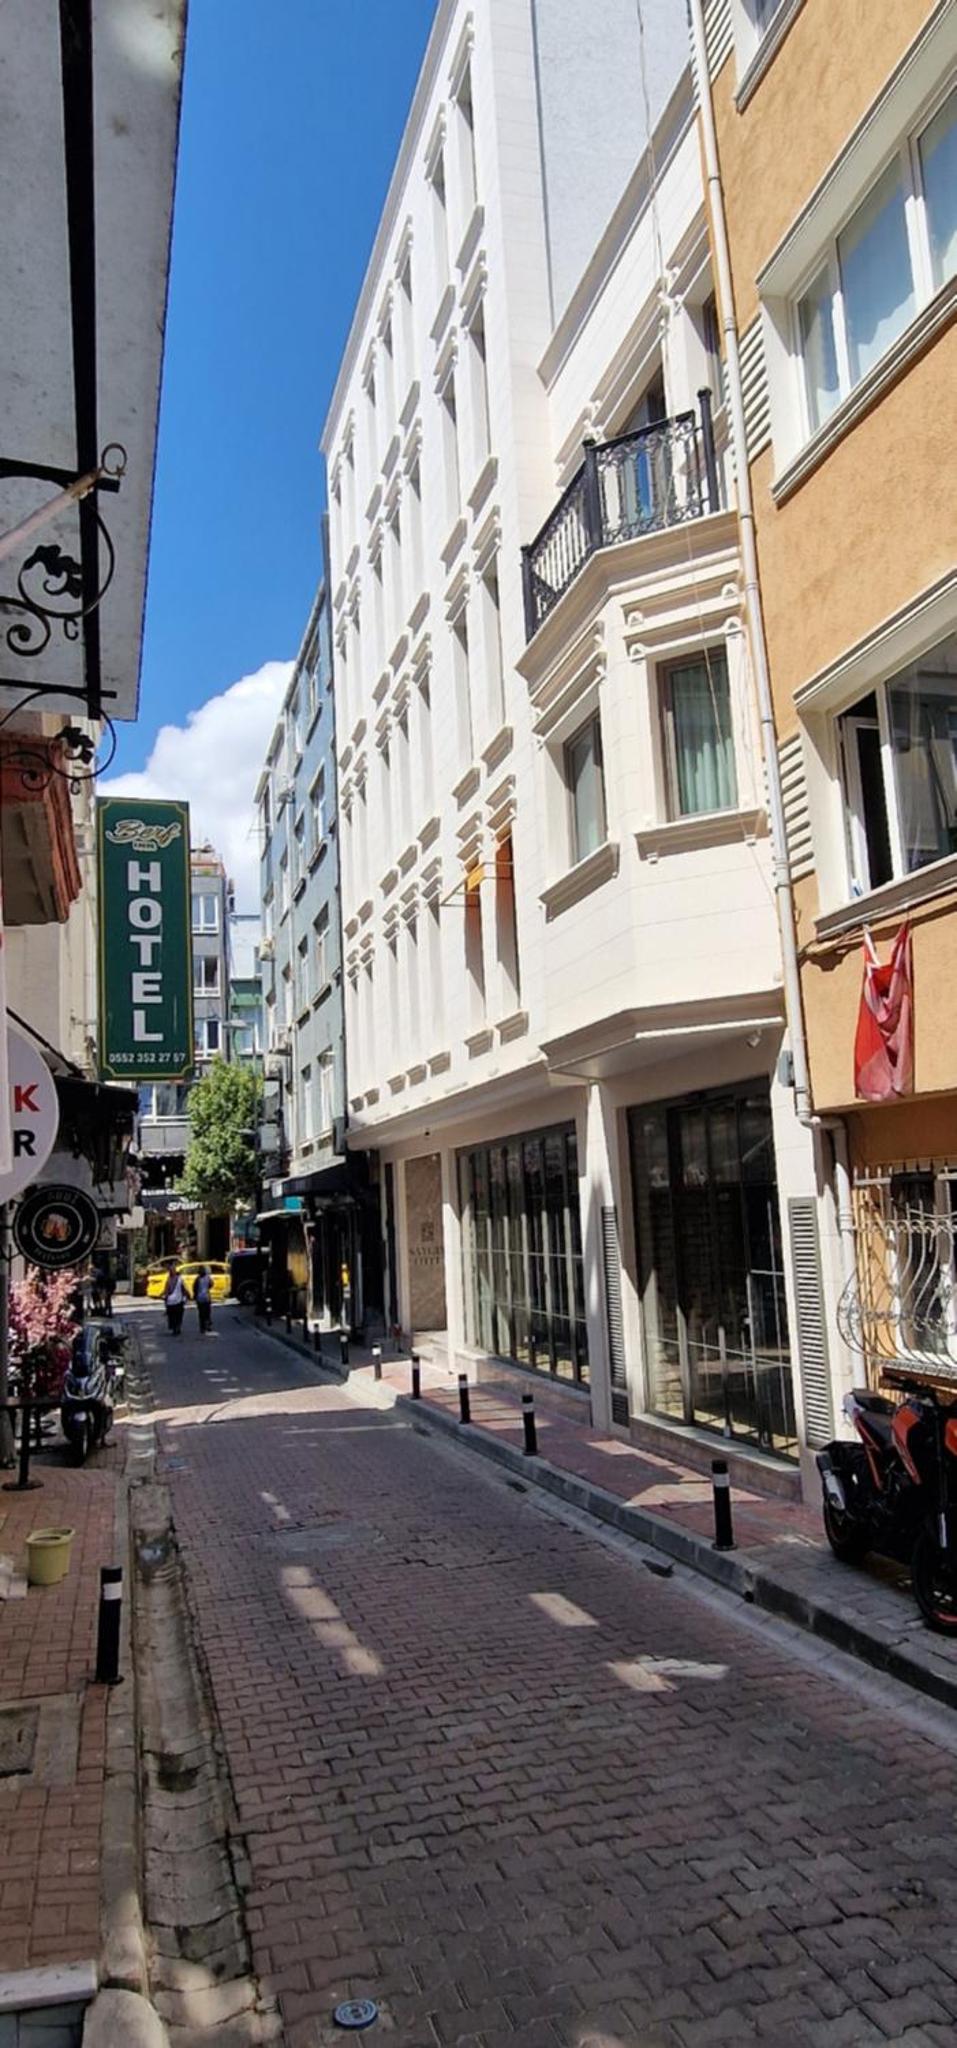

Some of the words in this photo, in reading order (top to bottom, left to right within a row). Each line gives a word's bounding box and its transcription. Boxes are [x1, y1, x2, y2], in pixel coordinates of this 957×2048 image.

[128, 861, 164, 1041] HOTEL
[108, 1052, 135, 1063] 0552
[136, 1052, 156, 1063] 352
[158, 1052, 171, 1063] 27
